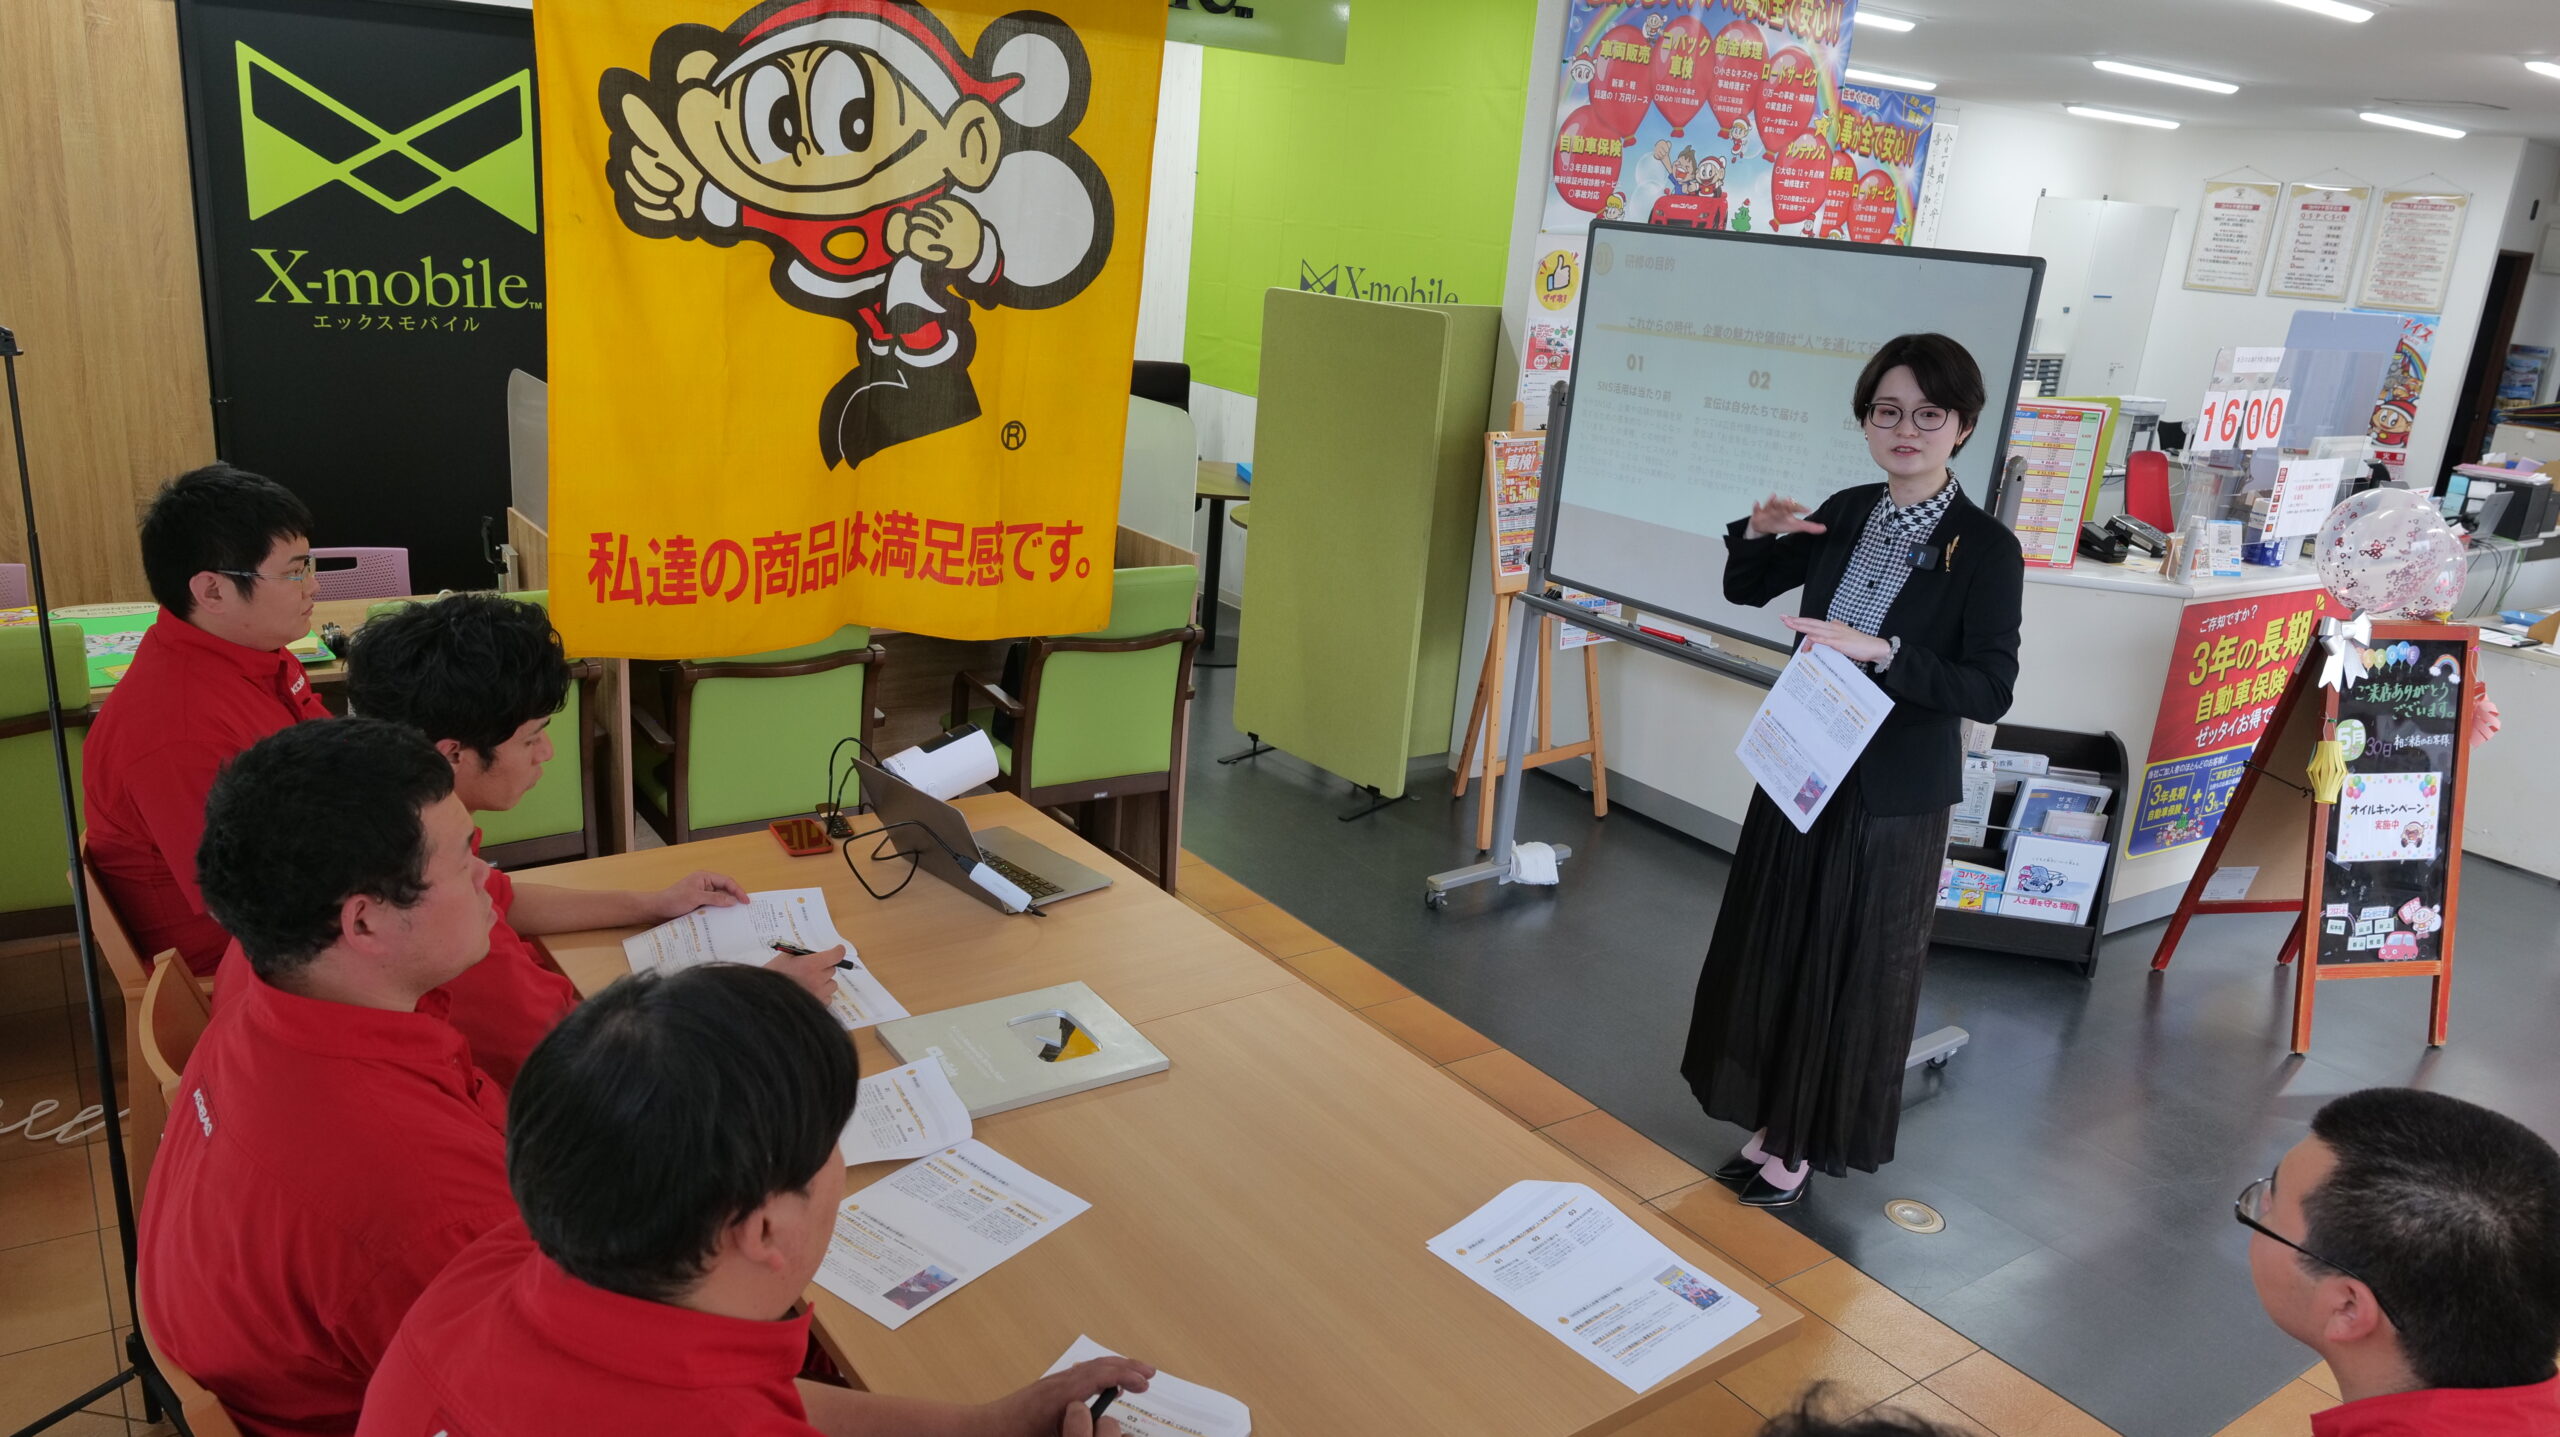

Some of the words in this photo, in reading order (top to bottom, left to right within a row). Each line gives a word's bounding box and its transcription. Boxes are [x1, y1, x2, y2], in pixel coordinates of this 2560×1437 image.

[1600, 40, 1651, 65] 車両販売
[1662, 32, 1711, 56] コバック
[1669, 55, 1695, 80] 車検
[1762, 64, 1818, 88] ロードサービス
[1560, 135, 1622, 157] 自動車保険
[1624, 254, 1675, 272] 研修の目的
[251, 248, 529, 309] X-mobile
[313, 312, 481, 333] エックスモバイル
[1626, 354, 1645, 373] 01
[1748, 371, 1771, 390] 02
[1703, 396, 1810, 424] 宣伝は自分たちで届ける
[588, 510, 1090, 607] 私達の商品は満足感です。
[2200, 604, 2258, 633] ご存知ですか？
[2188, 610, 2314, 686] 3年の長期
[2195, 666, 2288, 724] 自動車保険
[2355, 682, 2449, 702] ご来店ありがとう
[2392, 701, 2455, 719] ございます。
[2365, 737, 2392, 757] 30日
[2350, 803, 2425, 816] オイルキャンペーン
[2375, 820, 2400, 830] 実施中
